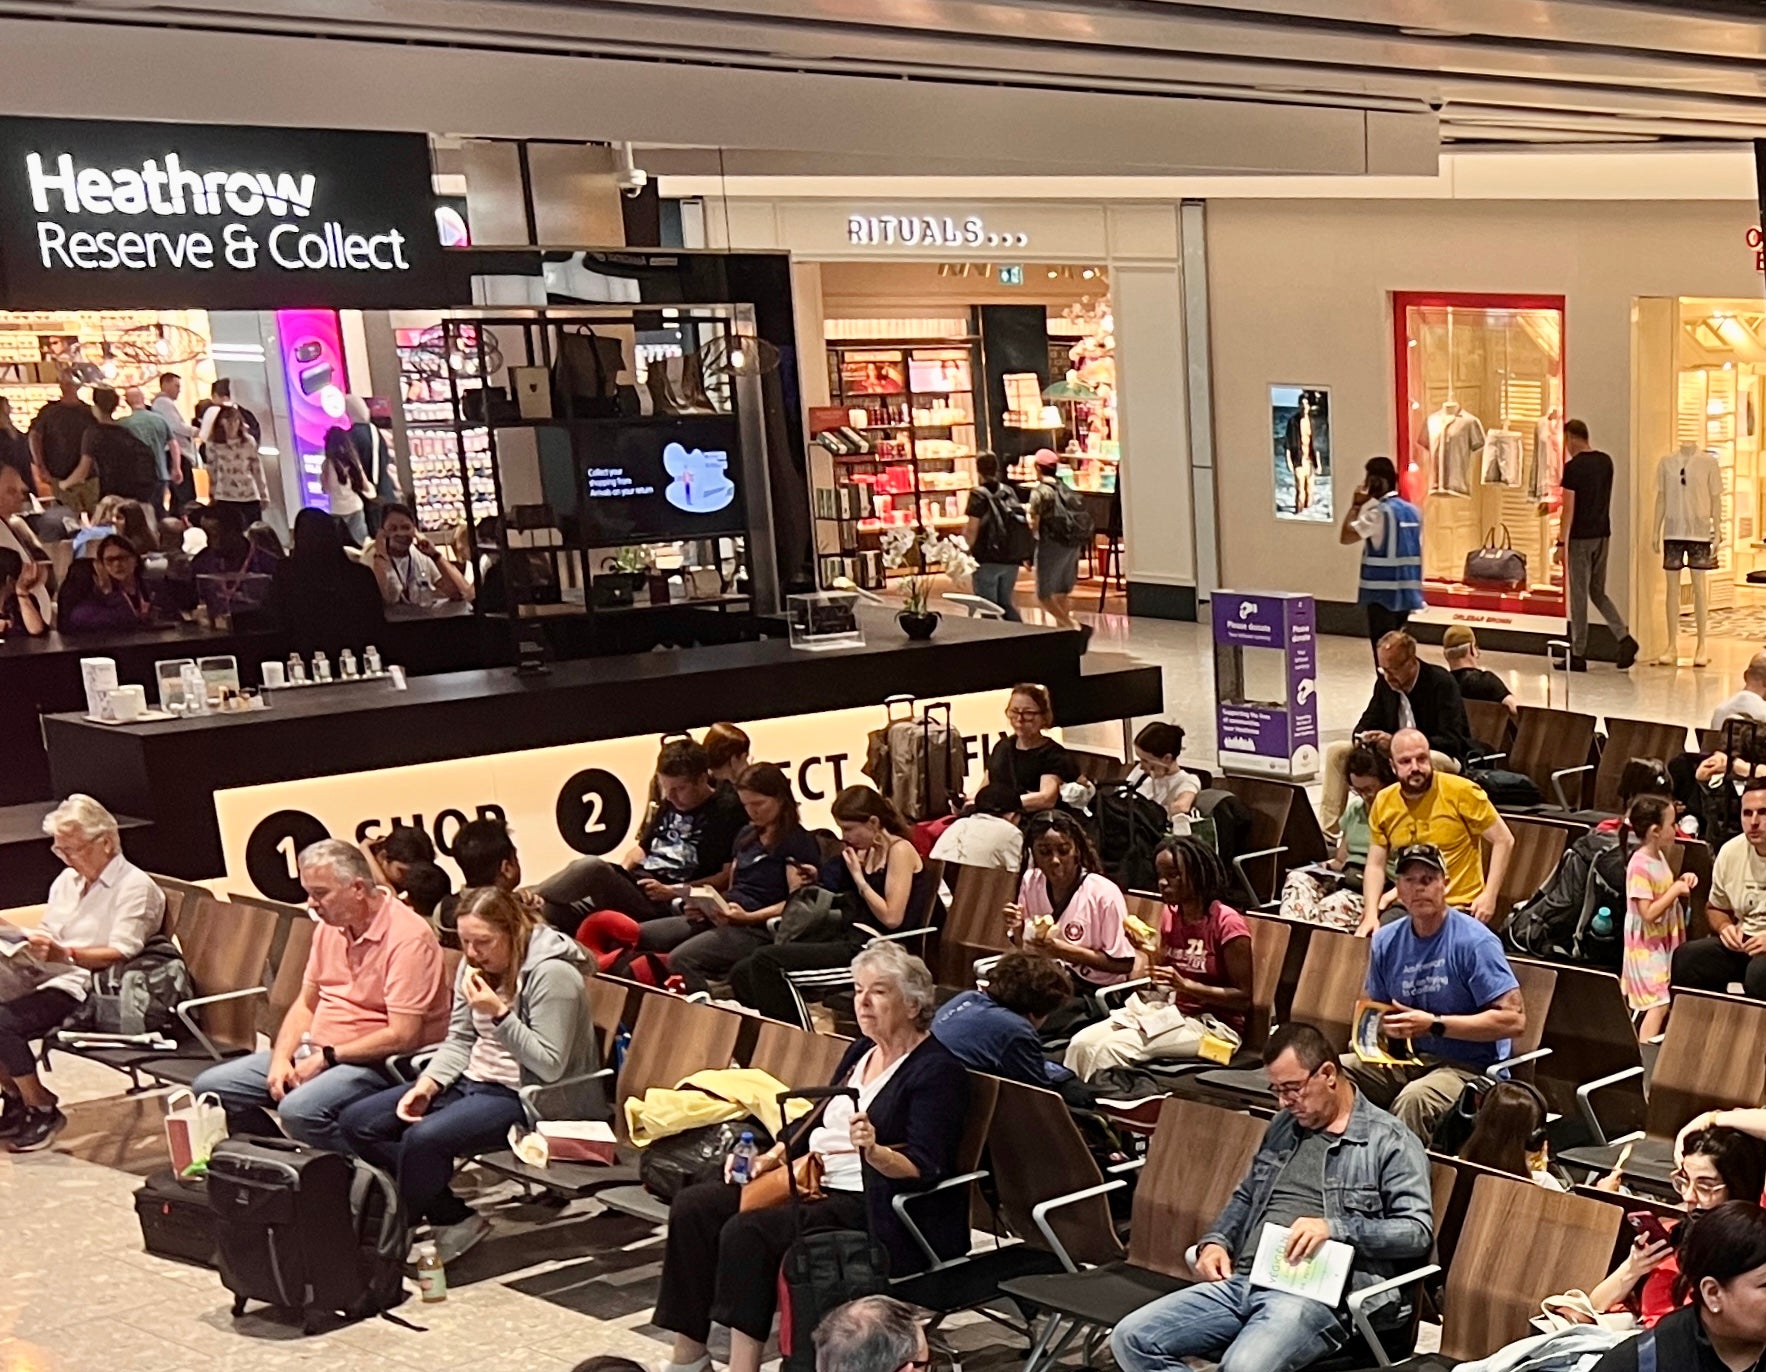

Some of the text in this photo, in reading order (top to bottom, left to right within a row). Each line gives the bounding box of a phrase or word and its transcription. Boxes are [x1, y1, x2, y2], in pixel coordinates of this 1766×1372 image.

[26, 151, 316, 216] Heathrow
[36, 221, 410, 270] Reserve & Collect
[581, 792, 606, 833] 2
[276, 836, 300, 879] 1
